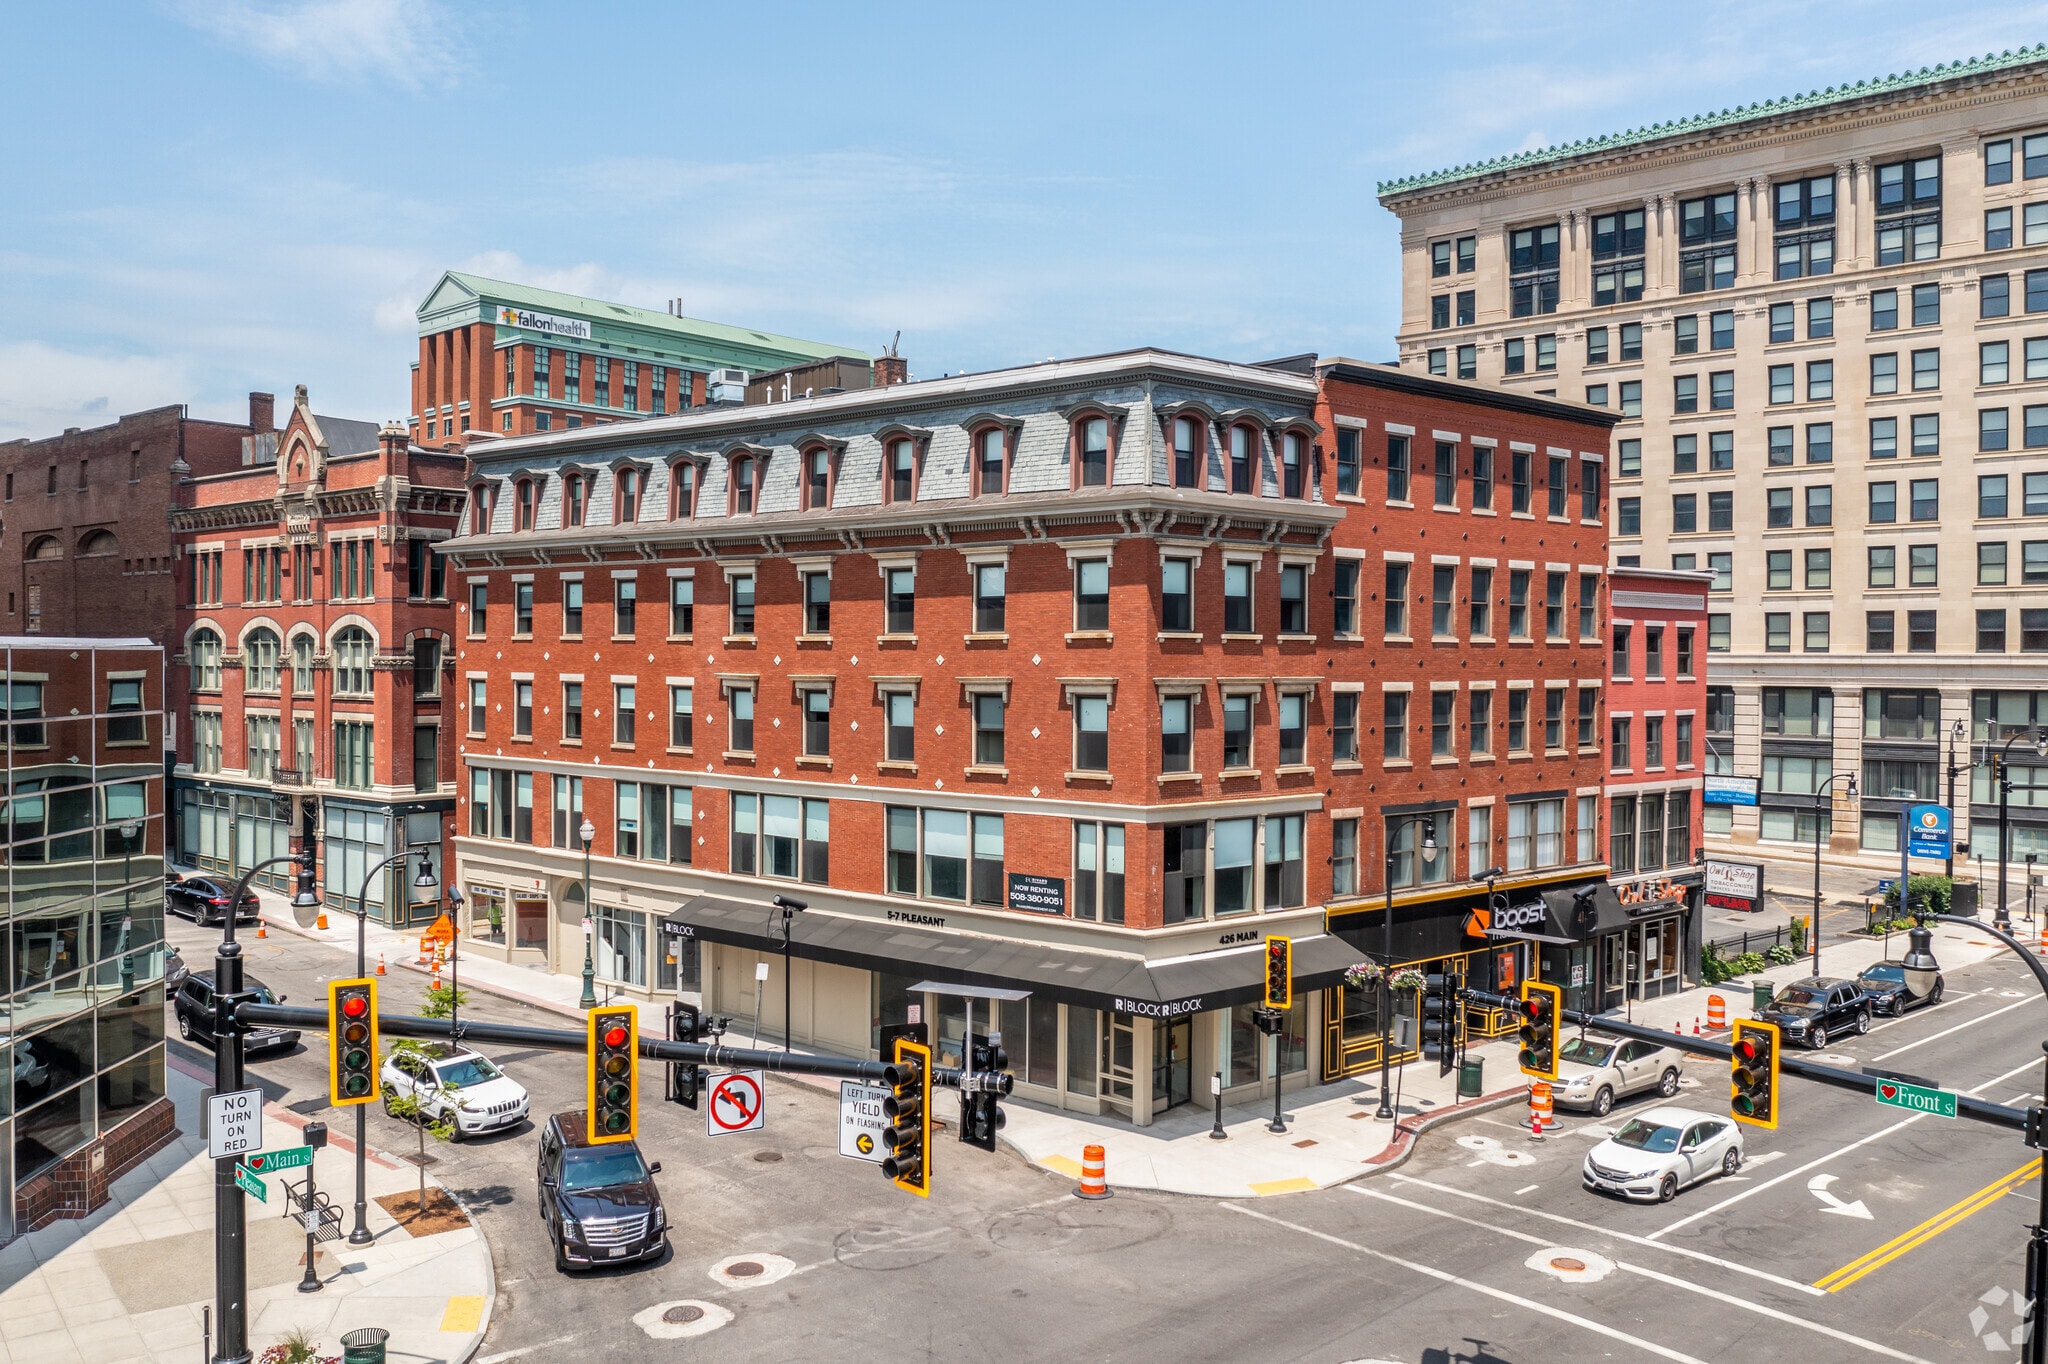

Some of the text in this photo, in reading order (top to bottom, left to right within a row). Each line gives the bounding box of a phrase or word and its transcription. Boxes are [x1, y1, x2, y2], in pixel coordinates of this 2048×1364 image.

[517, 311, 587, 337] fallonhealth
[1913, 825, 1947, 836] Commerce
[1921, 833, 1938, 841] Bank
[1709, 864, 1756, 883] Owl Shop
[1014, 884, 1059, 896] NOW RENTING
[1616, 880, 1646, 907] Owl
[1656, 877, 1688, 905] Shop
[1711, 880, 1754, 890] TOBACCONISTS
[1010, 892, 1063, 906] 508-380-9051
[887, 910, 946, 928] 5-7 PLEASANT
[1493, 898, 1548, 929] boost
[1219, 930, 1258, 945] 426 MAIN
[847, 1088, 886, 1103] LEFT TURN
[1897, 1085, 1954, 1115] Front St
[224, 1096, 247, 1111] NO
[852, 1100, 880, 1117] YIELD
[221, 1110, 251, 1124] TURN
[845, 1115, 885, 1131] ON FLASHING
[227, 1125, 245, 1137] ON
[224, 1138, 247, 1152] RED
[266, 1150, 311, 1170] Main St
[241, 1173, 262, 1196] Pleasant
